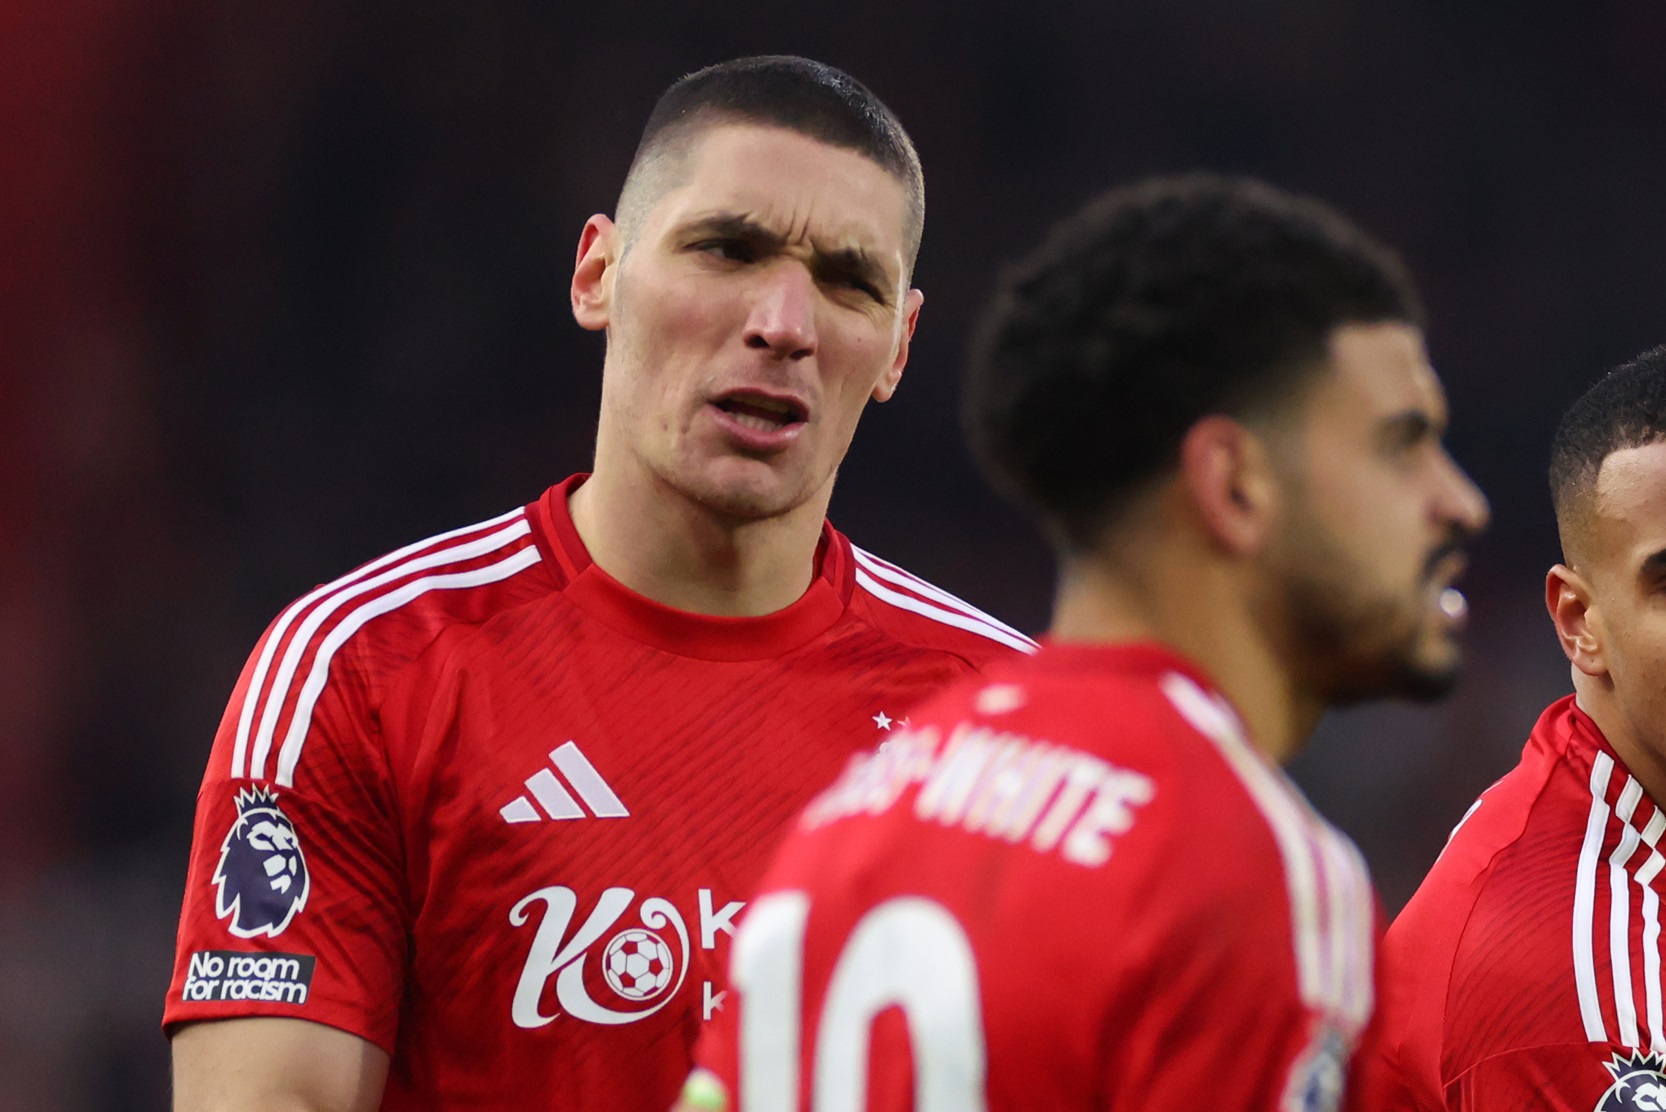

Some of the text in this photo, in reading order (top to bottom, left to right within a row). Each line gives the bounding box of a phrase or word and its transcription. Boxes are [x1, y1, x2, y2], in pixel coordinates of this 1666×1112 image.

[187, 951, 300, 980] No room
[182, 976, 308, 1004] for racism
